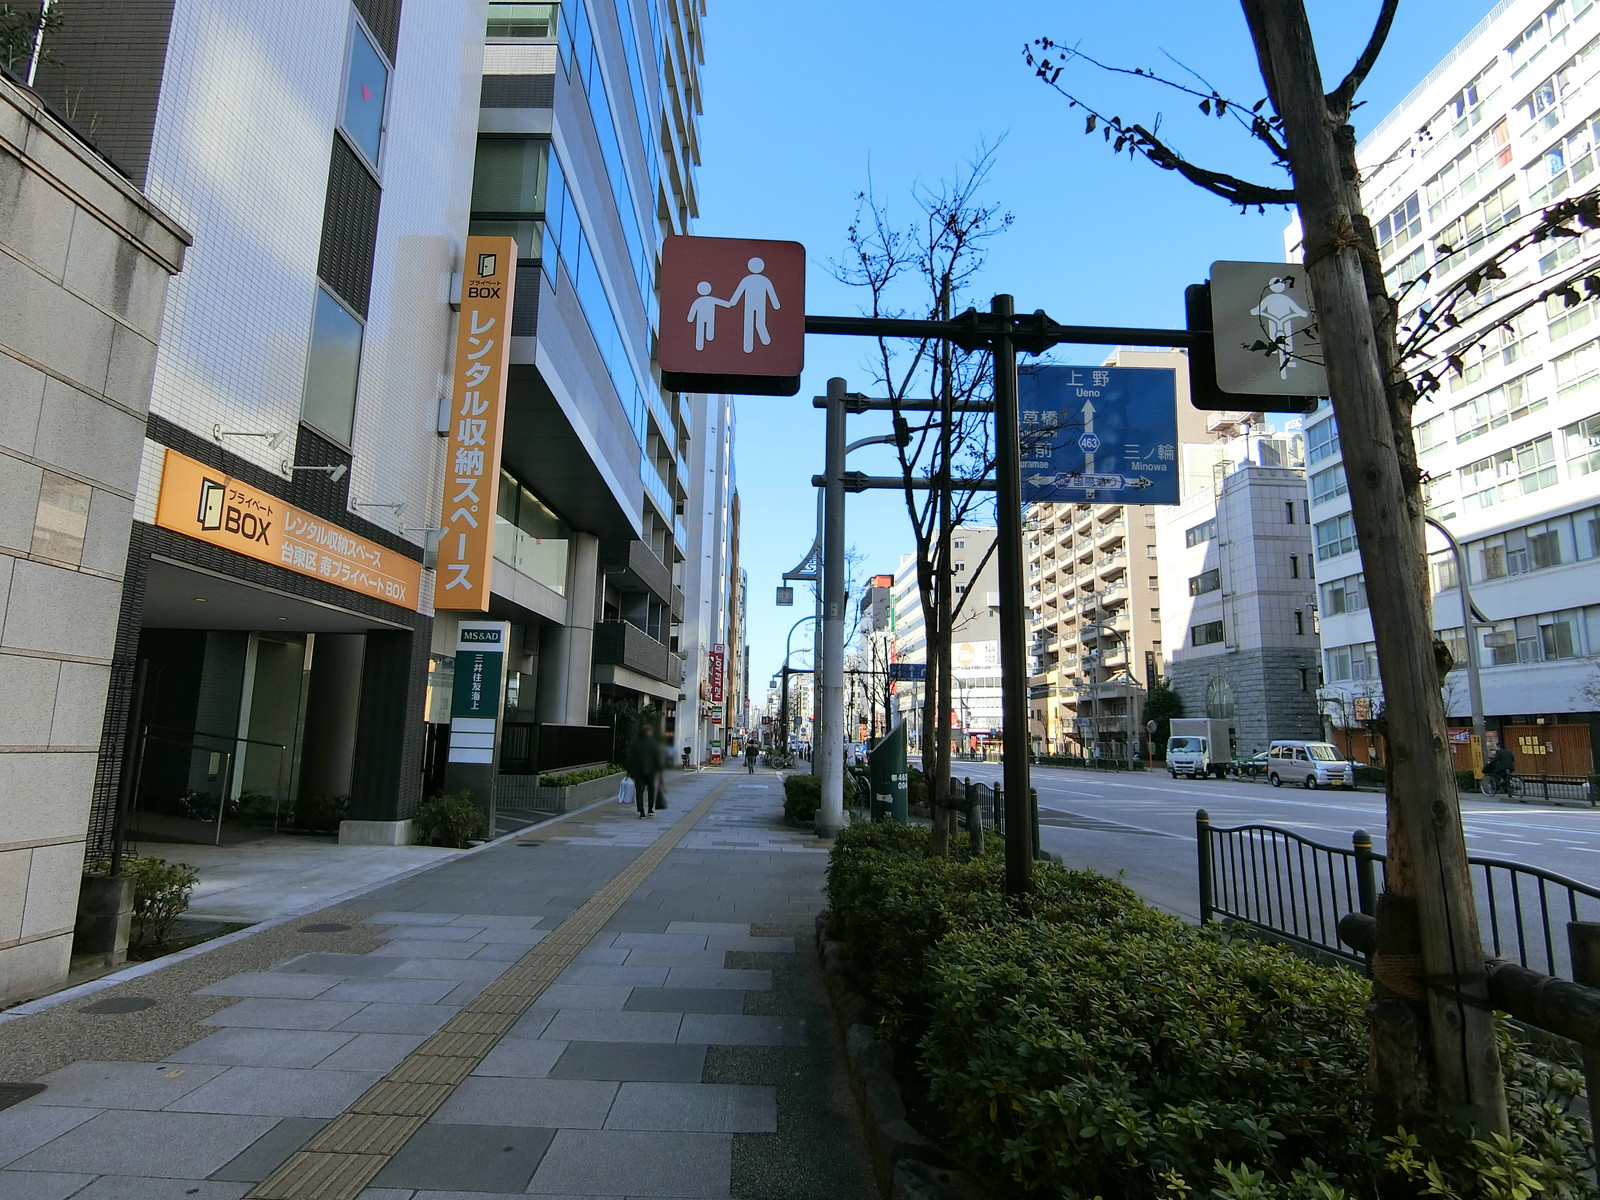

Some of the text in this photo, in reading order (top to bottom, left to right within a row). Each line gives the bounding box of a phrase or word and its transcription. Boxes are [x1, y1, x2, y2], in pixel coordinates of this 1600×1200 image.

[468, 287, 501, 299] BOX
[1066, 369, 1110, 388] 上野
[1076, 388, 1100, 398] Ueno
[1018, 410, 1059, 427] 草橋
[444, 310, 496, 590] レンタル収納スペース
[1081, 438, 1097, 448] 463
[1123, 444, 1175, 461] 三ノ輪
[1020, 461, 1049, 469] uramae
[1131, 462, 1168, 472] Minowa
[229, 489, 273, 516] プライベート
[225, 505, 272, 546] BOX
[283, 511, 382, 568] レンタル収納スペース
[280, 541, 317, 572] 台東区
[464, 631, 499, 641] MS&AD
[470, 653, 484, 710] 三井住友海上
